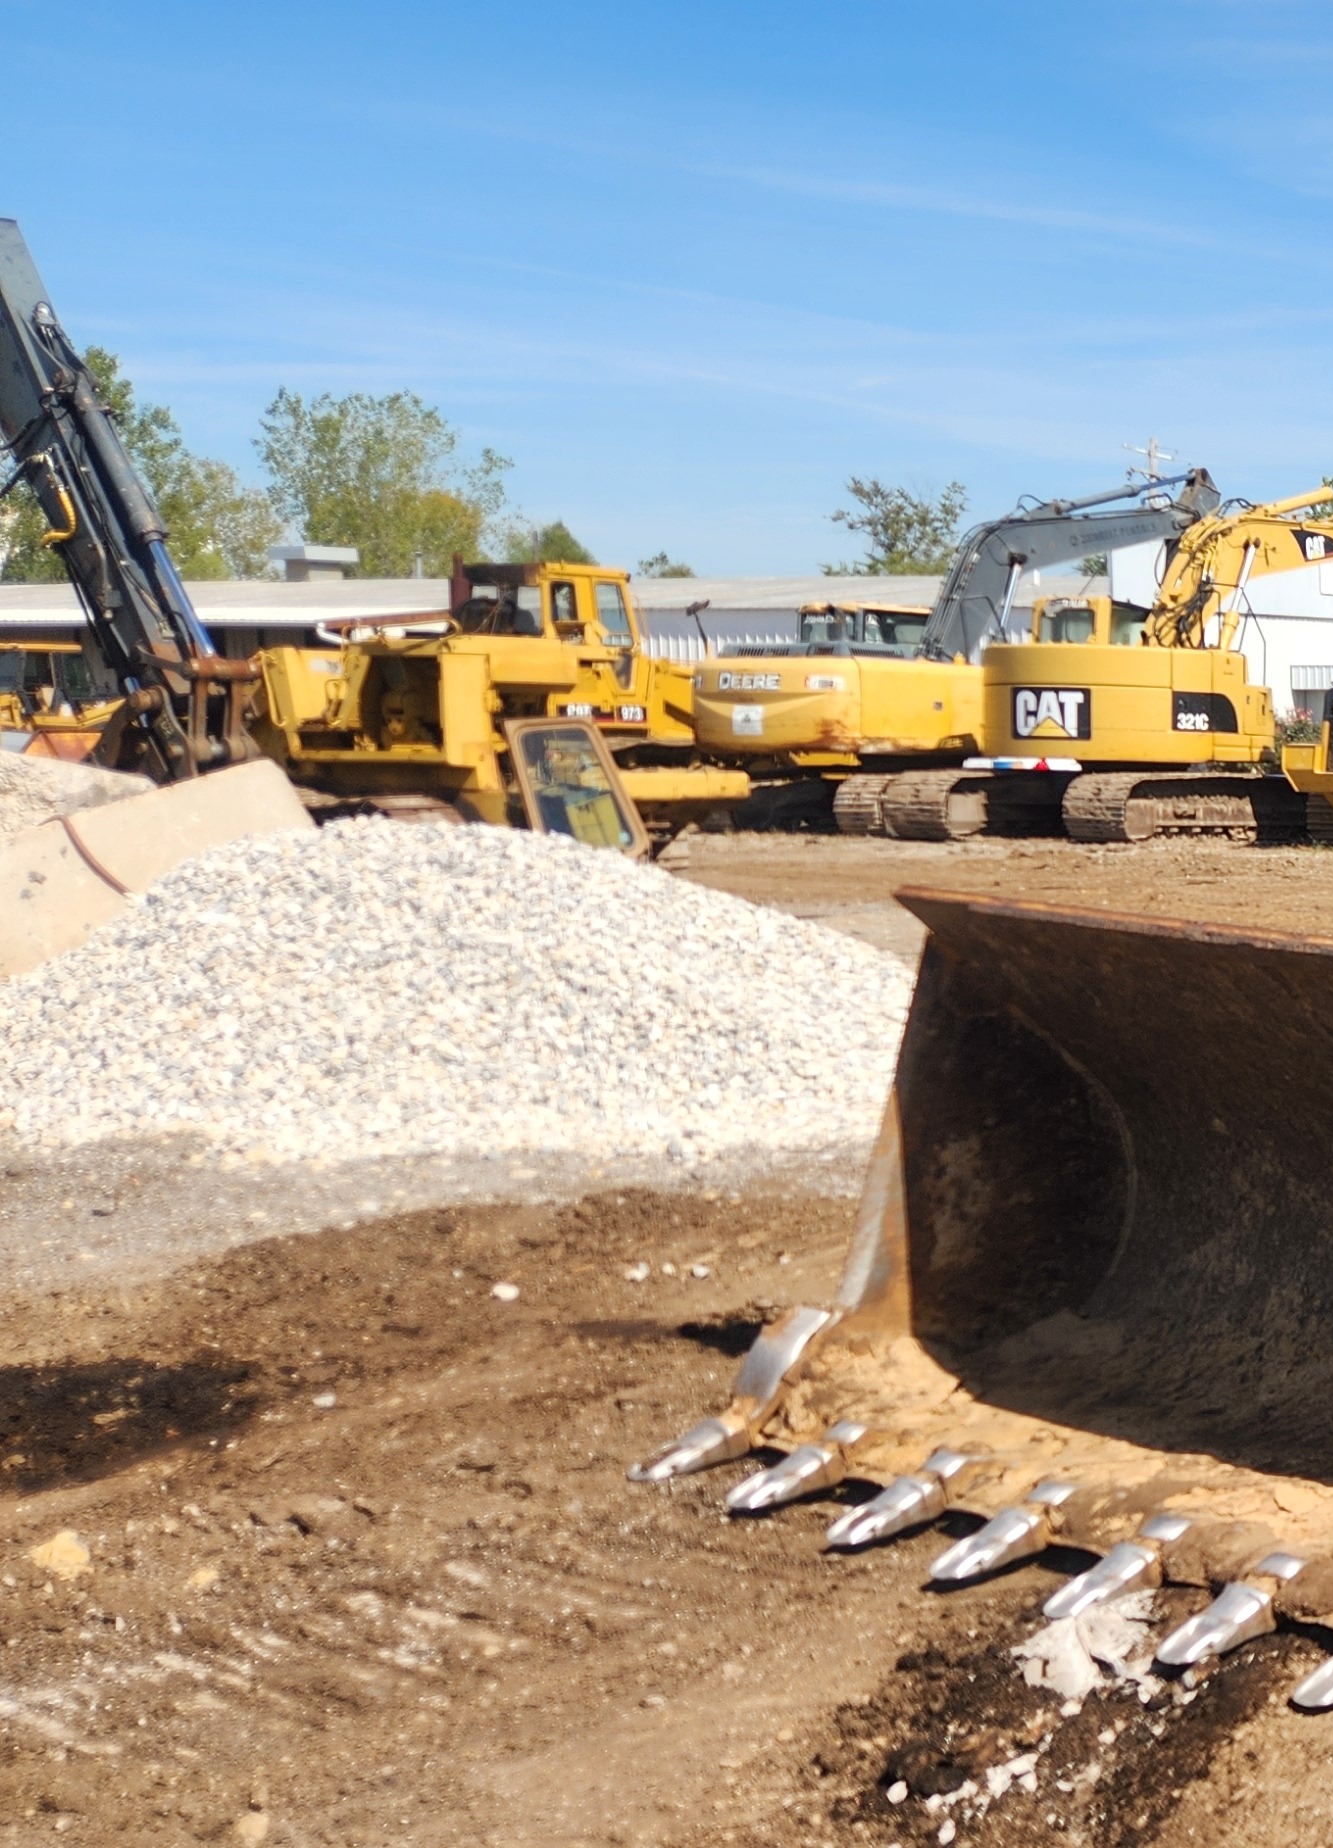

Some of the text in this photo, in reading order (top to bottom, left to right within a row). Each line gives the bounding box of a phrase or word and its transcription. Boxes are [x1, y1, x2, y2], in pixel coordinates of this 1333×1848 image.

[1305, 536, 1325, 560] CAT
[719, 671, 781, 691] DEERE
[621, 705, 644, 721] 973
[1015, 690, 1084, 738] CAT
[1177, 713, 1209, 731] 321C
